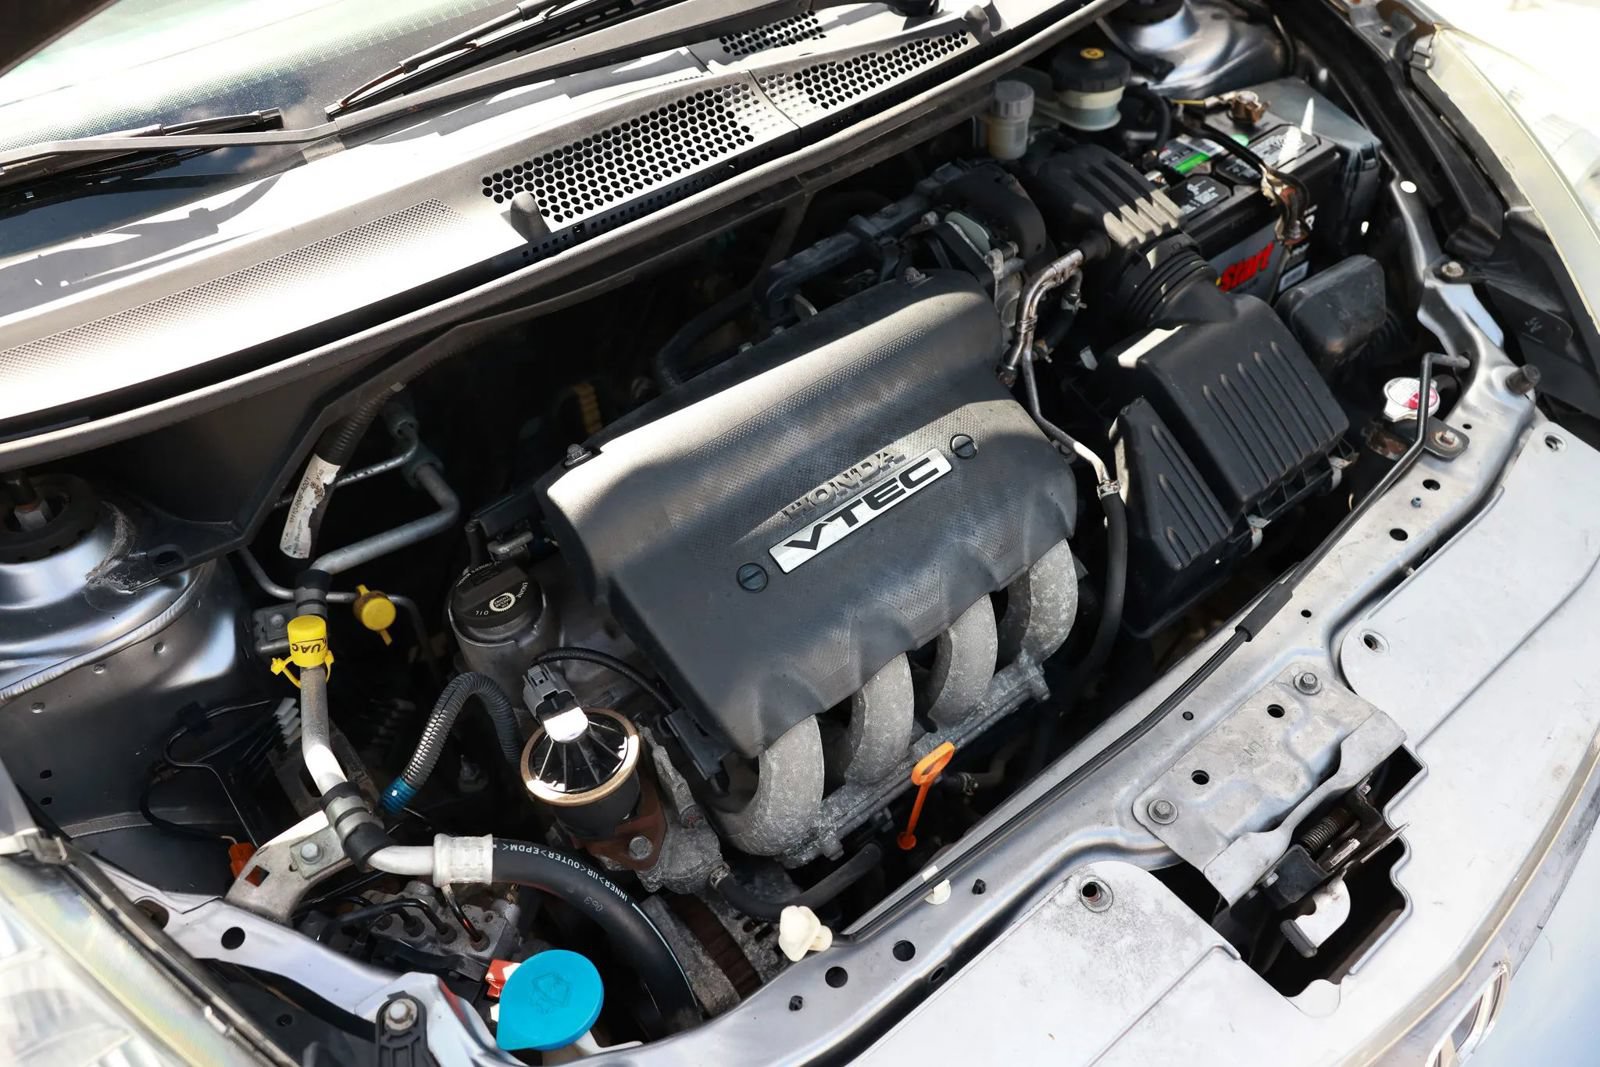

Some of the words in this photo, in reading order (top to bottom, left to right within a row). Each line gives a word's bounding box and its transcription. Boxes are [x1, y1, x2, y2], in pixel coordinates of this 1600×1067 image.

[1216, 240, 1275, 293] Start
[782, 450, 906, 519] HONDA
[783, 457, 940, 551] VTEC
[292, 643, 321, 654] UAC
